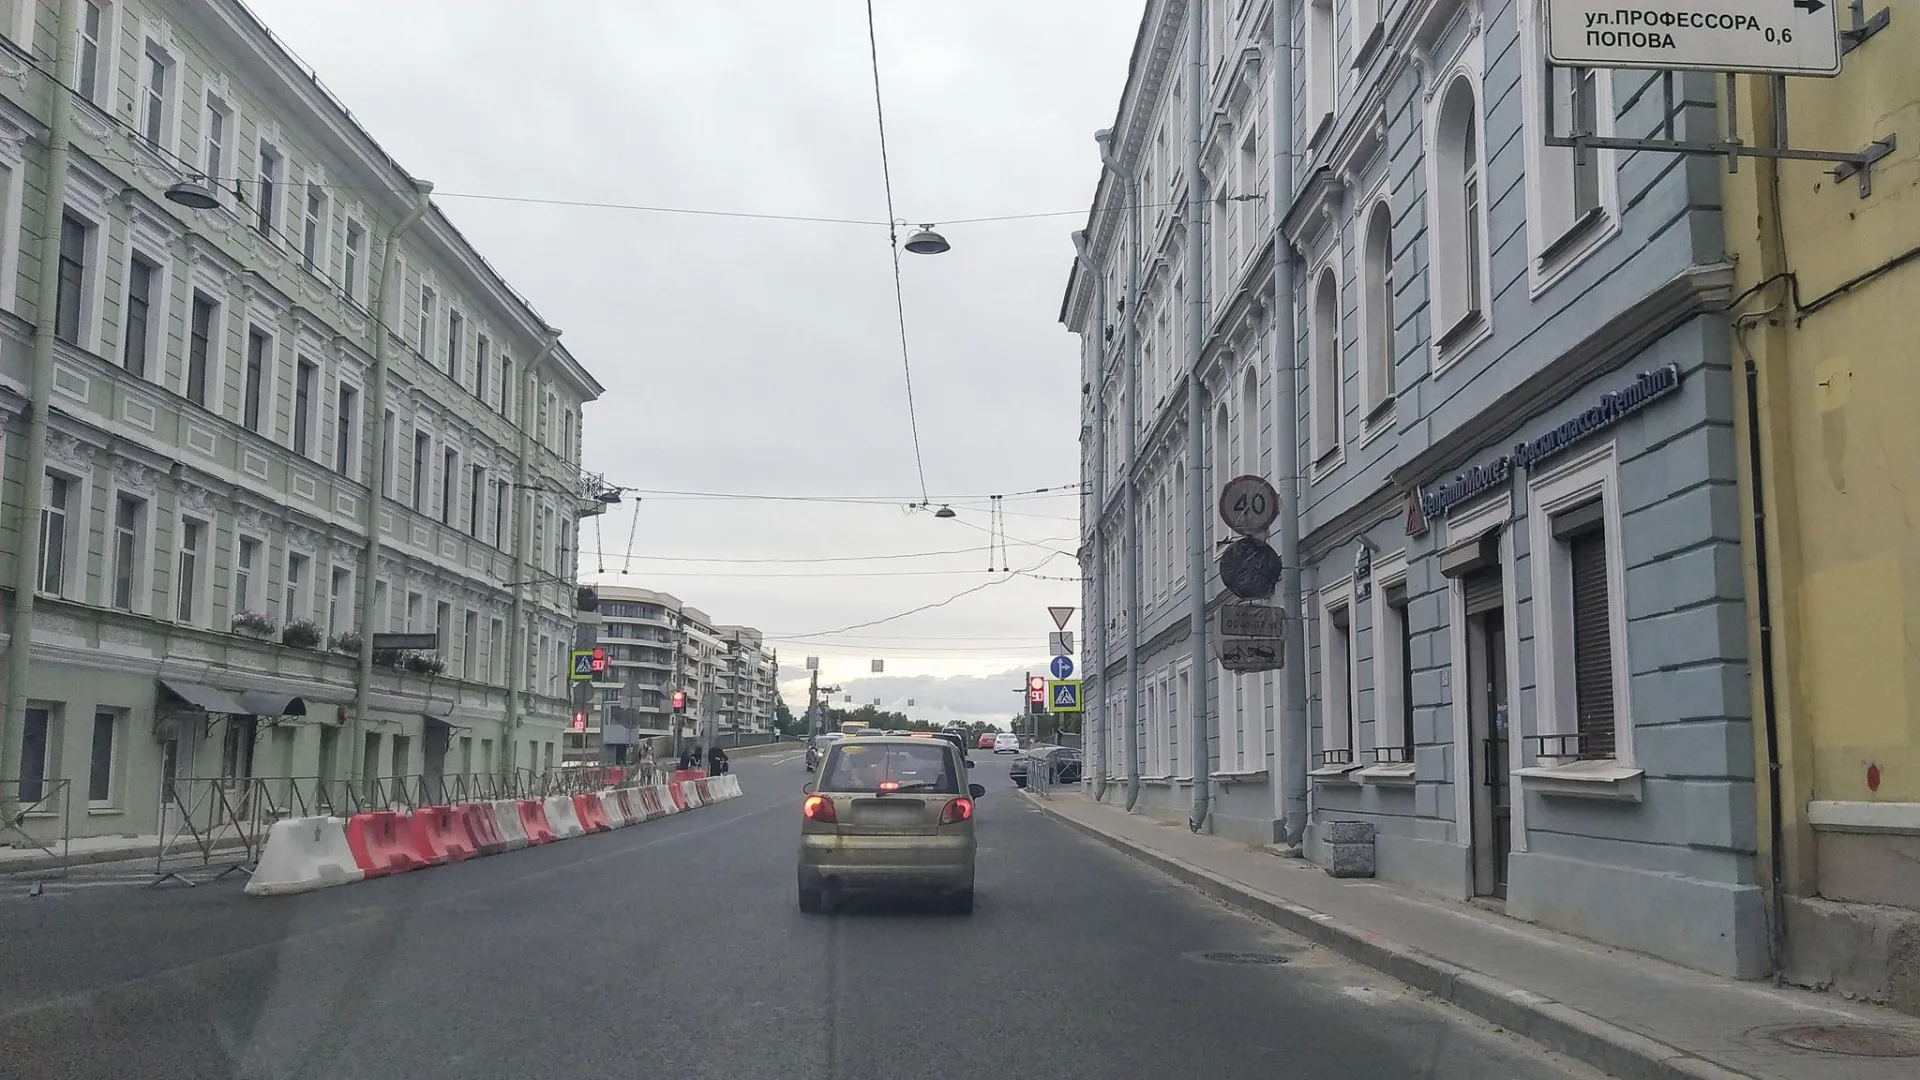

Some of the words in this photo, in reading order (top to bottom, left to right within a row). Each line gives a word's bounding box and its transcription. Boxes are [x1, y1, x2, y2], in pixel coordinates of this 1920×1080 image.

[1585, 9, 1761, 31] ул.ПРОФЕССОРА
[1586, 30, 1676, 49] ПОПОВА
[1764, 27, 1793, 46] 0,6
[1513, 432, 1556, 470] Краски
[1600, 366, 1675, 421] Premium
[1233, 493, 1266, 515] 40
[1422, 475, 1466, 517] Benjamin
[592, 660, 604, 670] 90
[1031, 690, 1043, 702] 90
